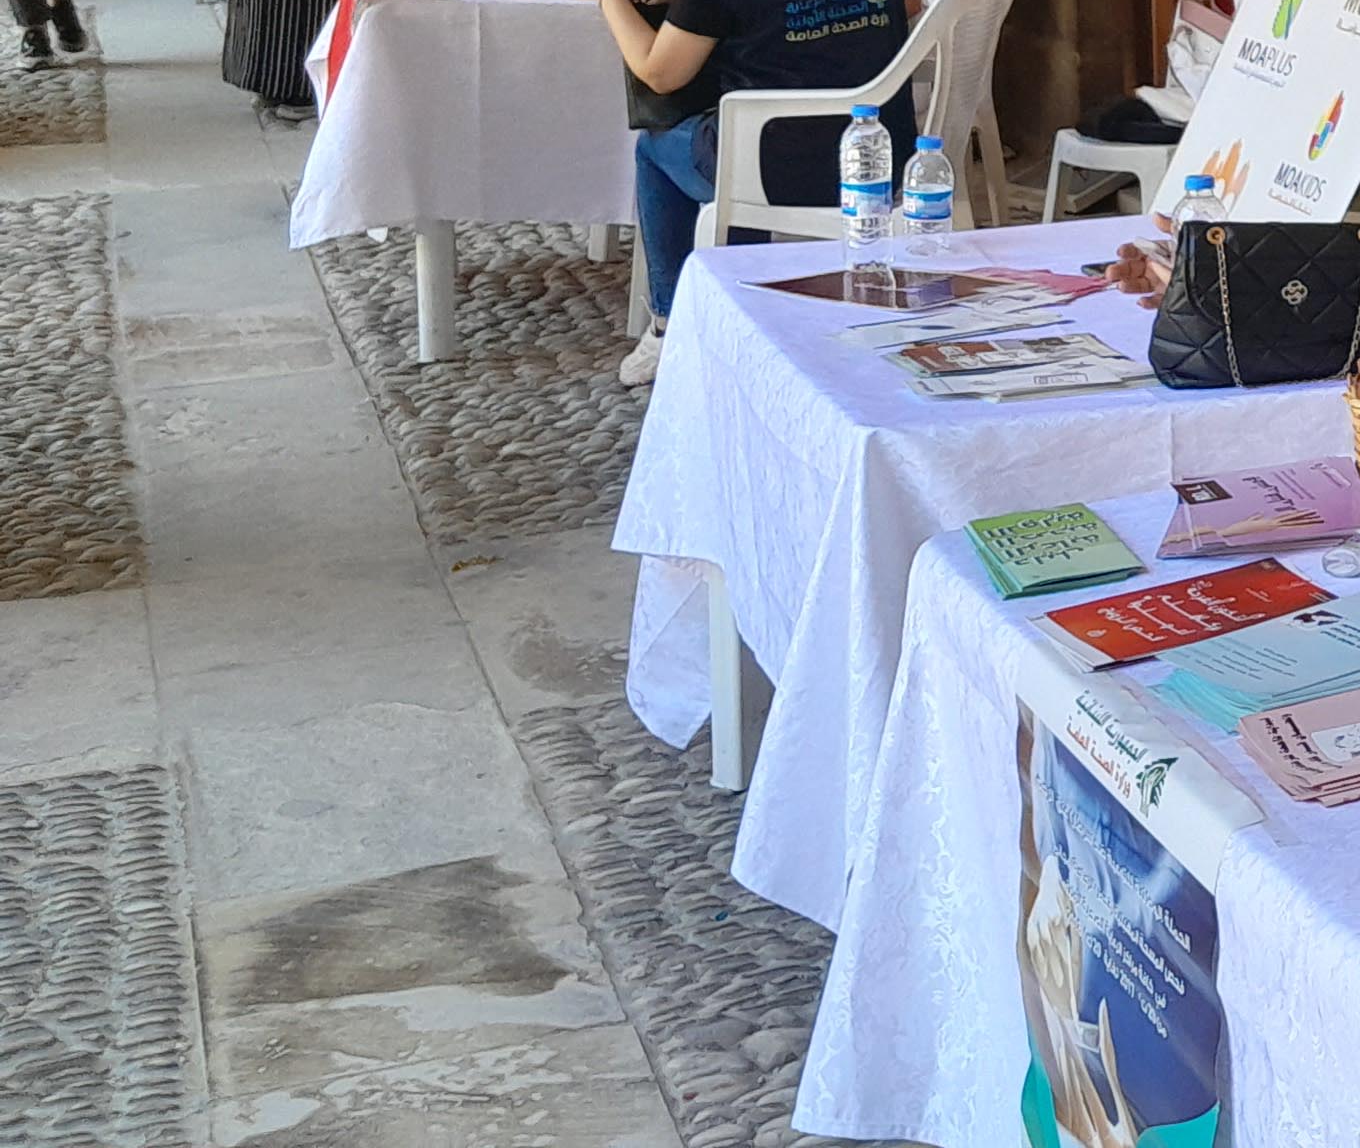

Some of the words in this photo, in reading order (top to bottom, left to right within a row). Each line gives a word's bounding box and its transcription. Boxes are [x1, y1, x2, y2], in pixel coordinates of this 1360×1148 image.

[1238, 38, 1297, 76] MOAPLUS
[1274, 161, 1327, 203] MOAKIDS
[1076, 690, 1112, 727] اللبنانية
[1105, 719, 1150, 764] الجمهورية
